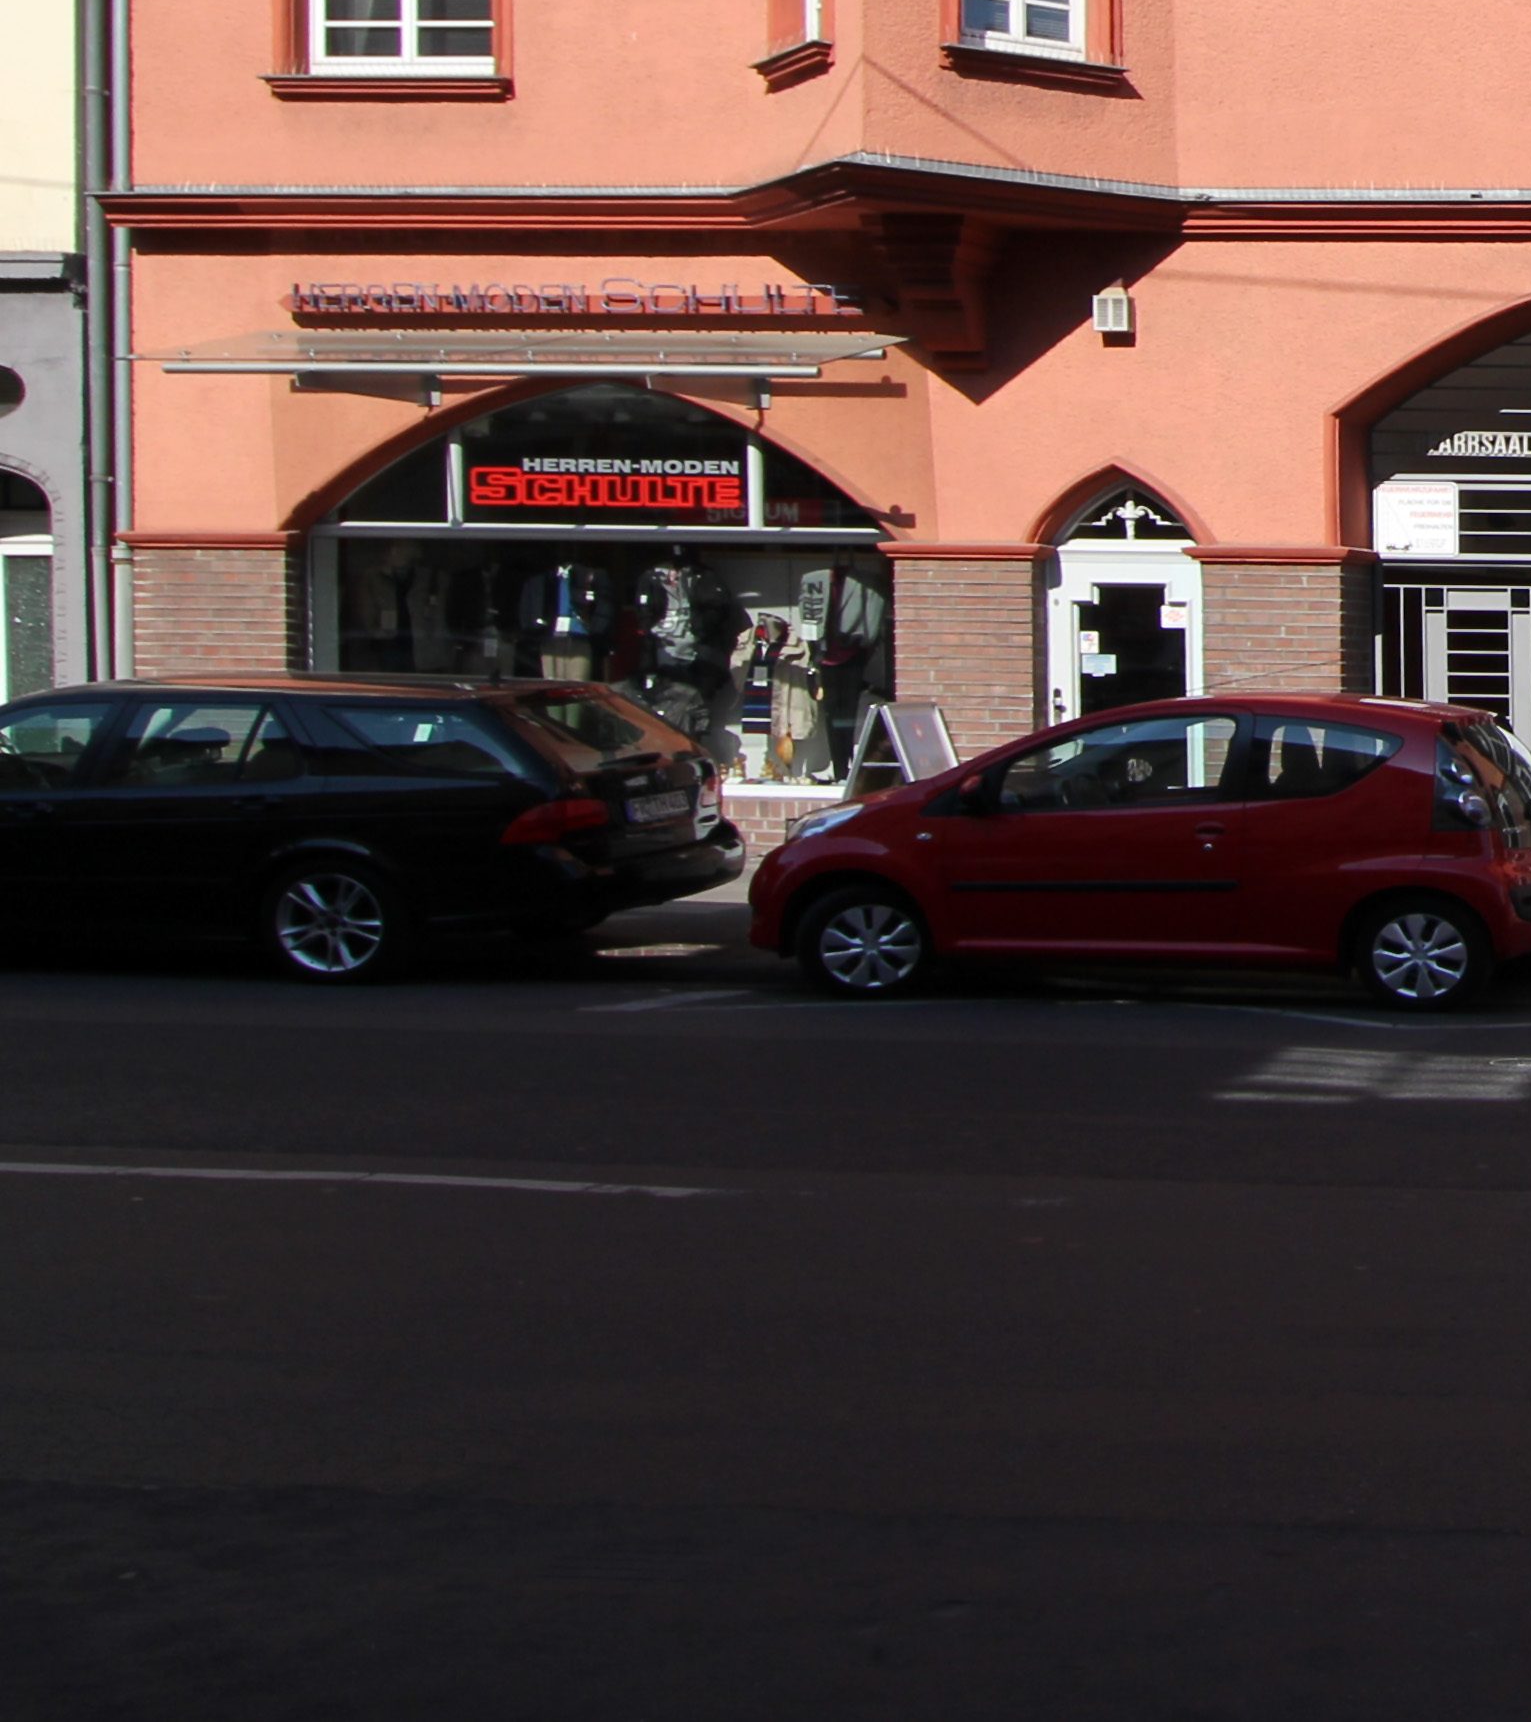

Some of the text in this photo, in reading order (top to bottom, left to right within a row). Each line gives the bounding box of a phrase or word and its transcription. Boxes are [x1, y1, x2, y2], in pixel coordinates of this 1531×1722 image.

[291, 282, 586, 313] HERREN-MODEN
[522, 457, 739, 475] HERREN-MODEN
[469, 466, 741, 508] SCHULTE
